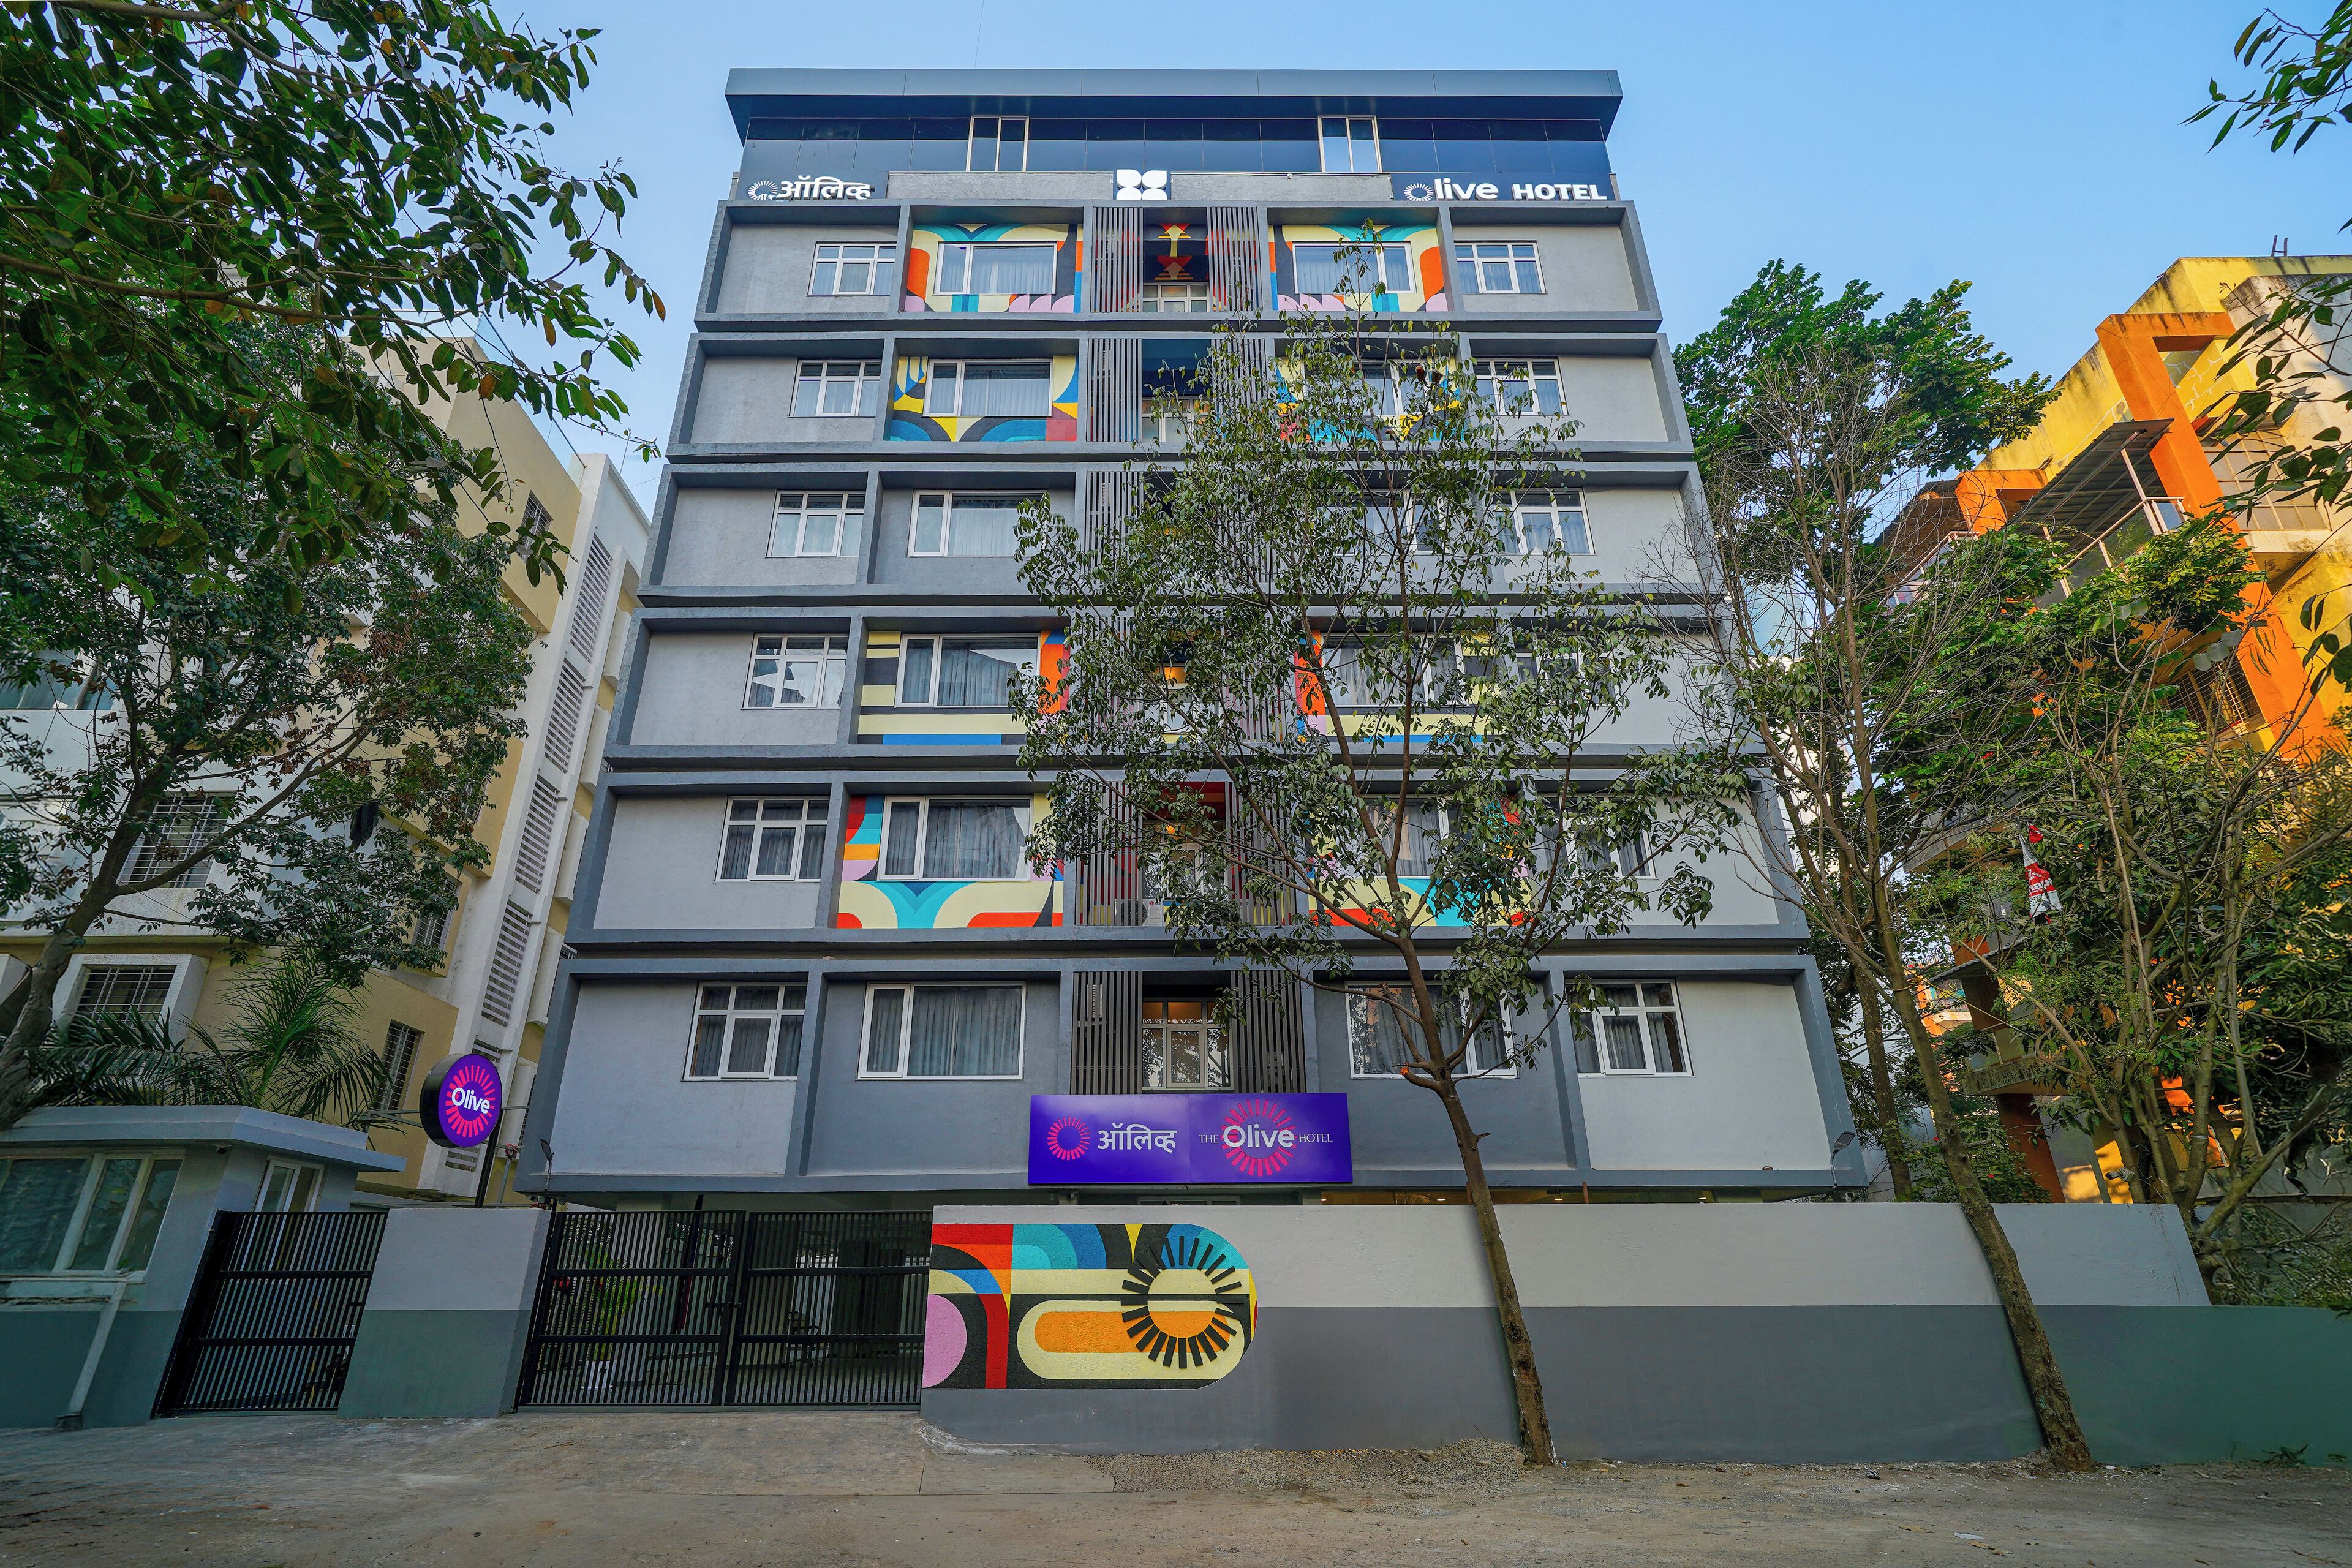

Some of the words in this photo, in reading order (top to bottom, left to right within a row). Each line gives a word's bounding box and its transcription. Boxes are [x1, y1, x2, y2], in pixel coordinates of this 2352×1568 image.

[776, 175, 871, 200] ऑलिव्ह
[1512, 184, 1607, 200] HOTEL
[451, 1087, 490, 1114] Olive
[1098, 1123, 1177, 1153] ऑलिव्ह
[1199, 1134, 1219, 1144] THE
[1223, 1124, 1295, 1148] Olive
[1298, 1134, 1333, 1143] HOTEL
